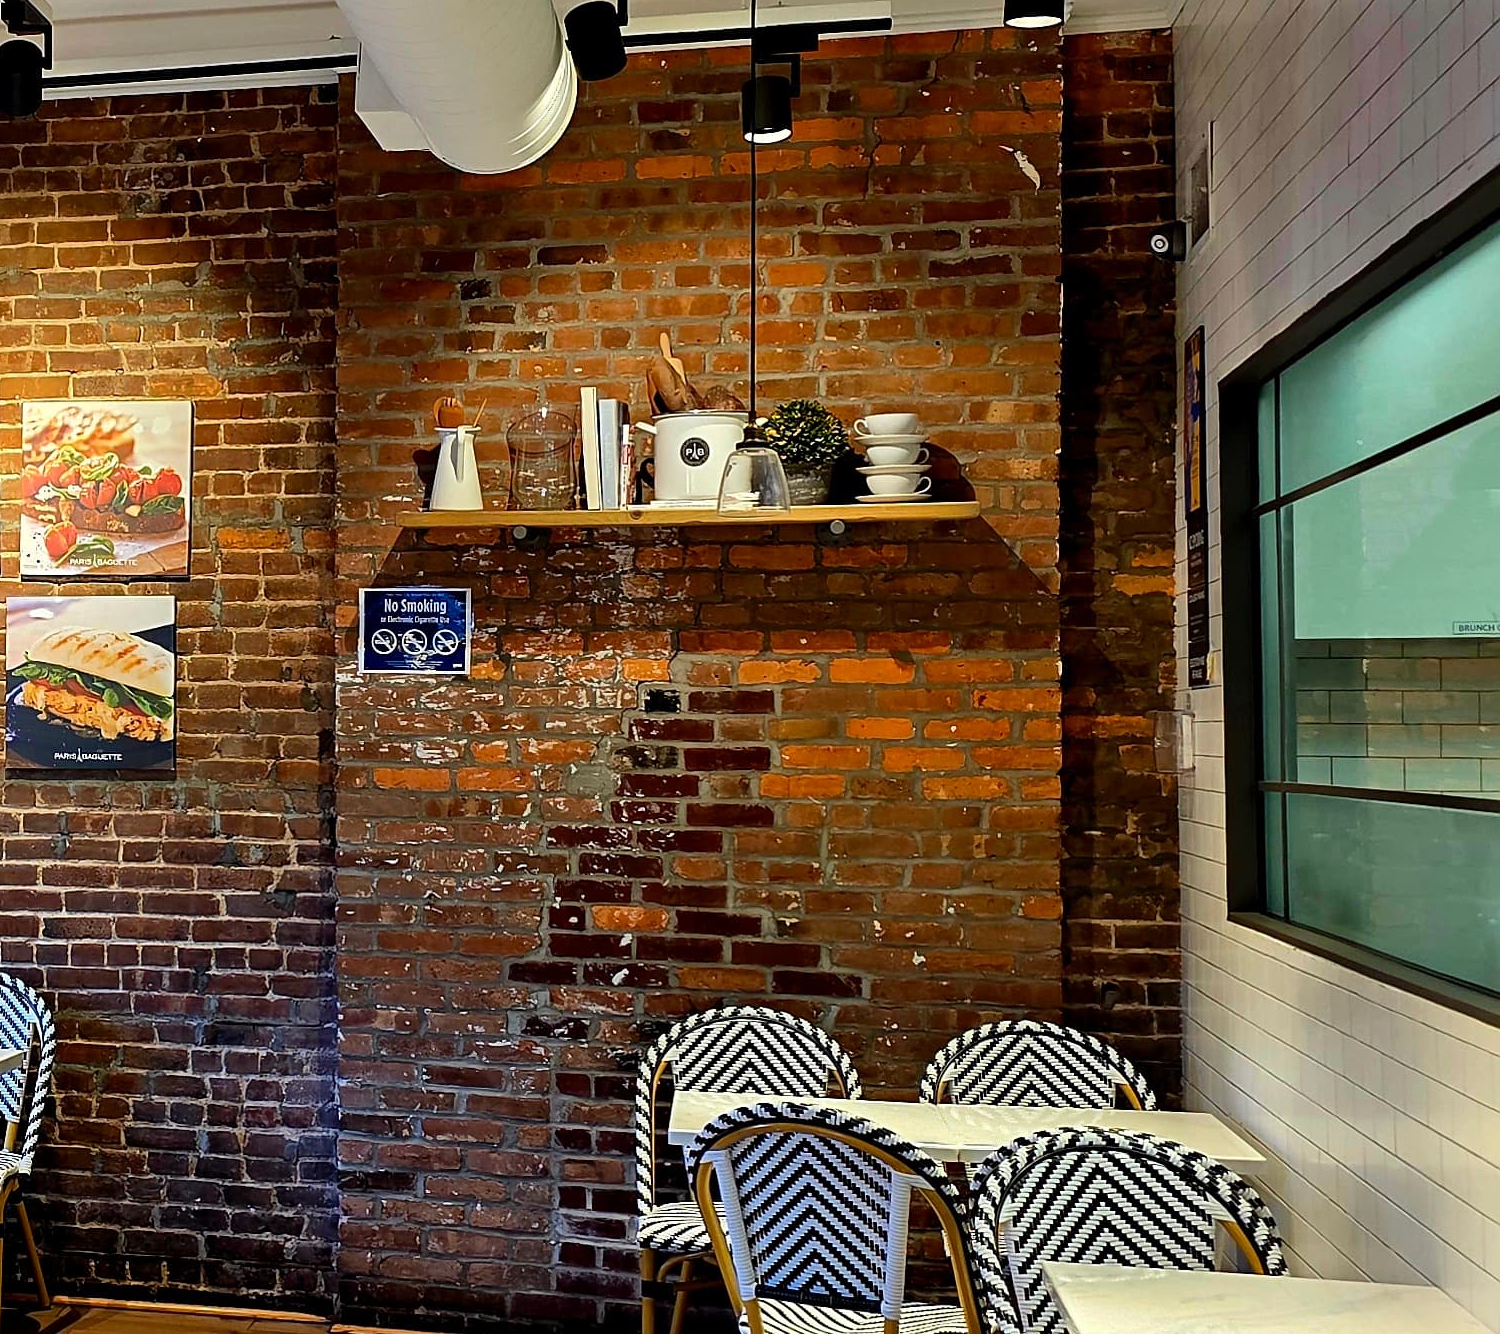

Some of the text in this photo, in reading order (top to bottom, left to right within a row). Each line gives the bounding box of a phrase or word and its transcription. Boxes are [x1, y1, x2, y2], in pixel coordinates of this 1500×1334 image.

[69, 558, 138, 566] PARIS BAGUETTE
[384, 598, 447, 615] No Smoking
[1458, 624, 1496, 632] BRUNCH
[54, 752, 77, 760] PARIS
